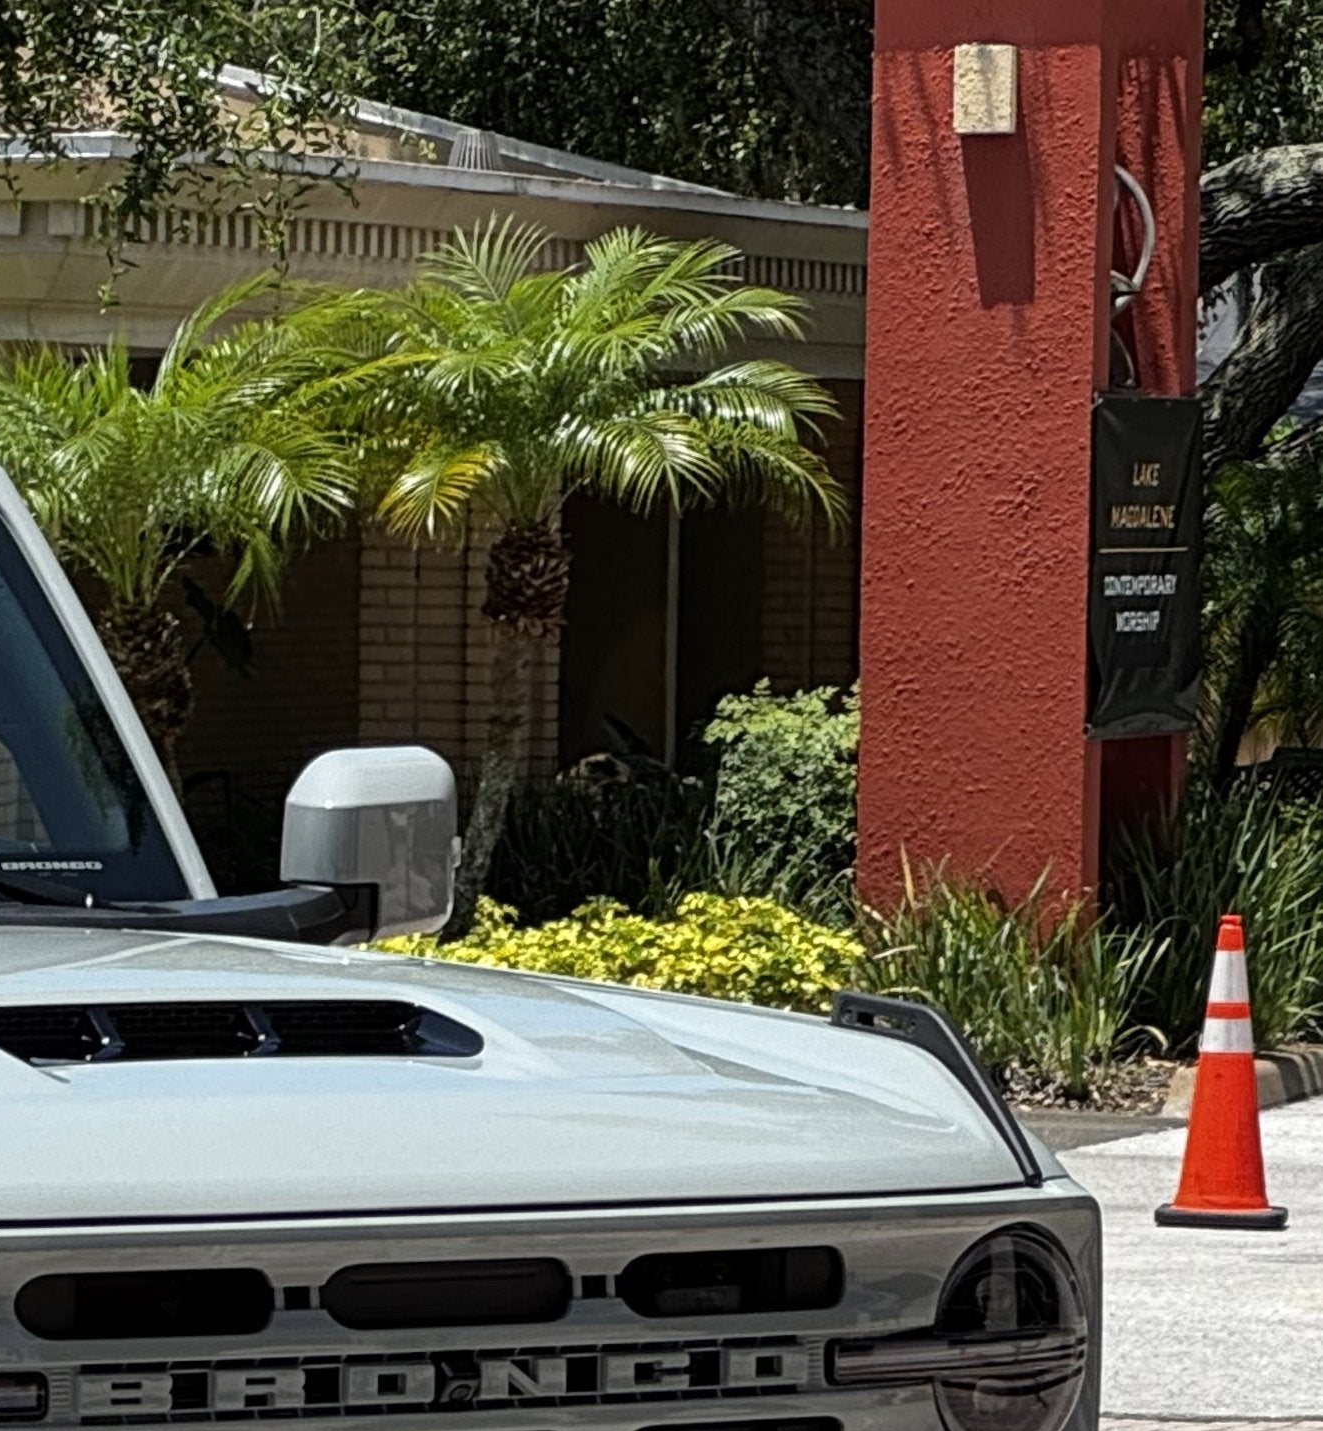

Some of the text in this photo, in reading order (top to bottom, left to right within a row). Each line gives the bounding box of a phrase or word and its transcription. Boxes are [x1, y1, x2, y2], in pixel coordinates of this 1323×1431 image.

[1132, 463, 1161, 487] LAKE
[1111, 505, 1176, 528] MAGDALENE
[1104, 574, 1178, 596] CONTEMPORARY
[1116, 611, 1160, 632] WORSHIP
[77, 1347, 794, 1418] BRONCO
